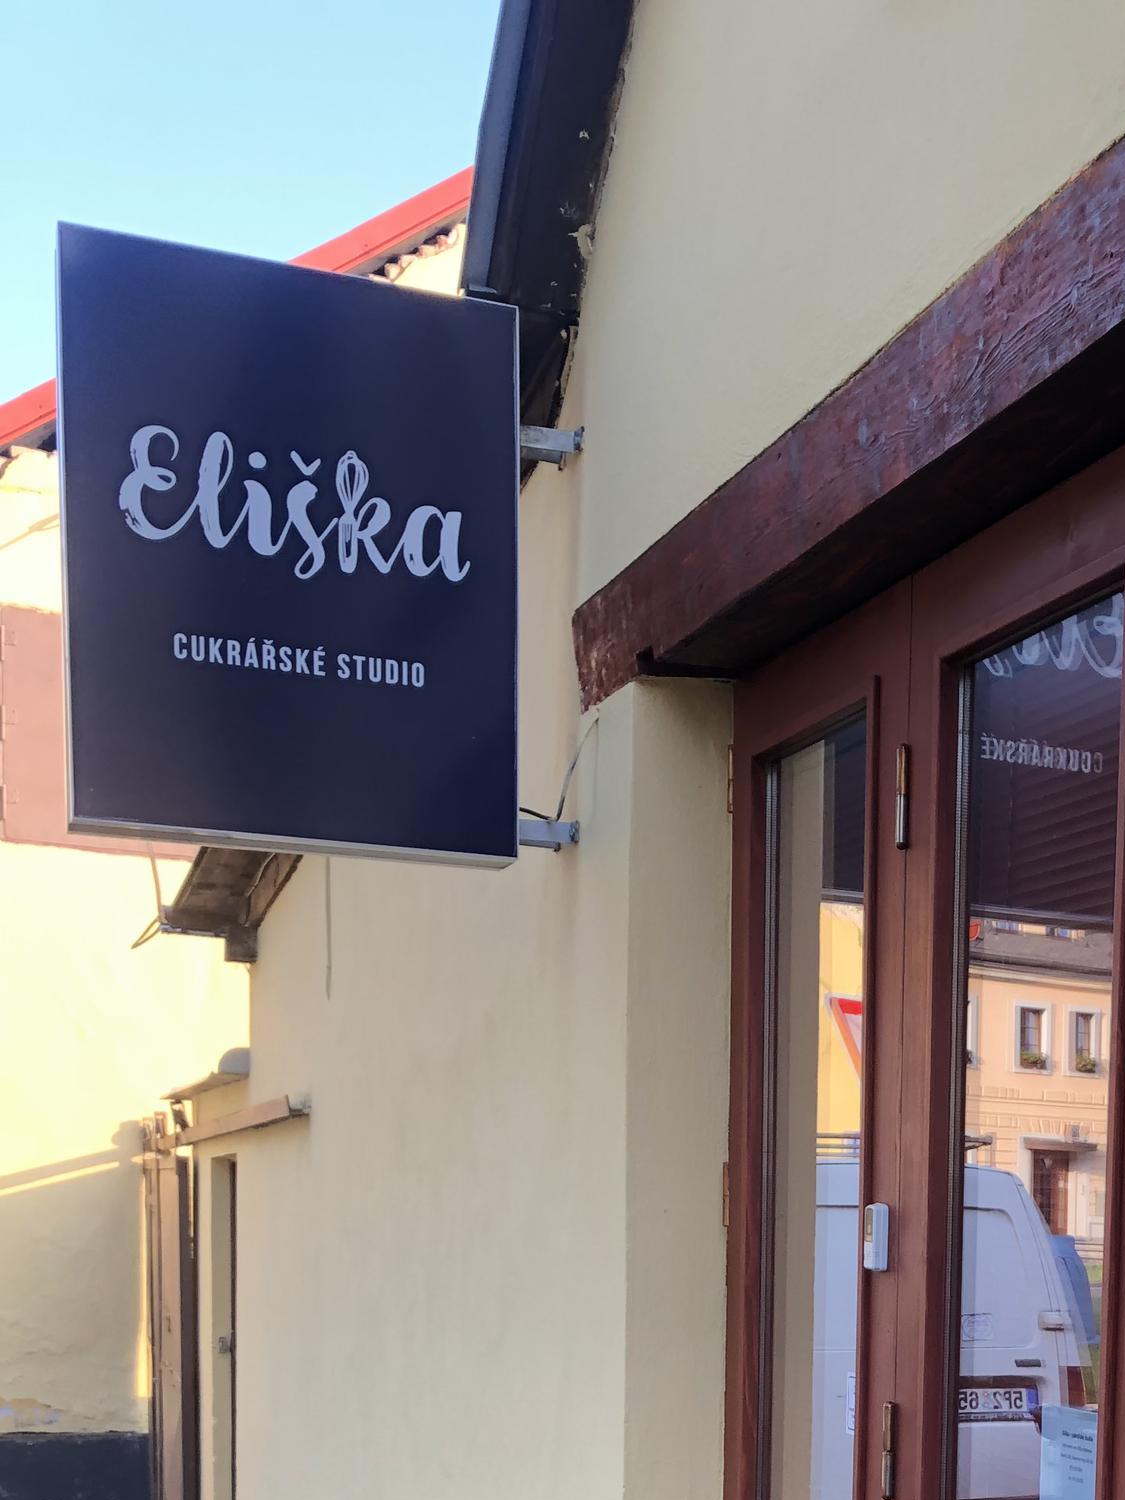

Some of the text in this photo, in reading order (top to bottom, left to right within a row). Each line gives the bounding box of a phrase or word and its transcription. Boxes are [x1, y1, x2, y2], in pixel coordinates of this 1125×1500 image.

[118, 424, 471, 582] Eliška
[173, 632, 425, 688] CUKRÁŘSKÉ STUDIO
